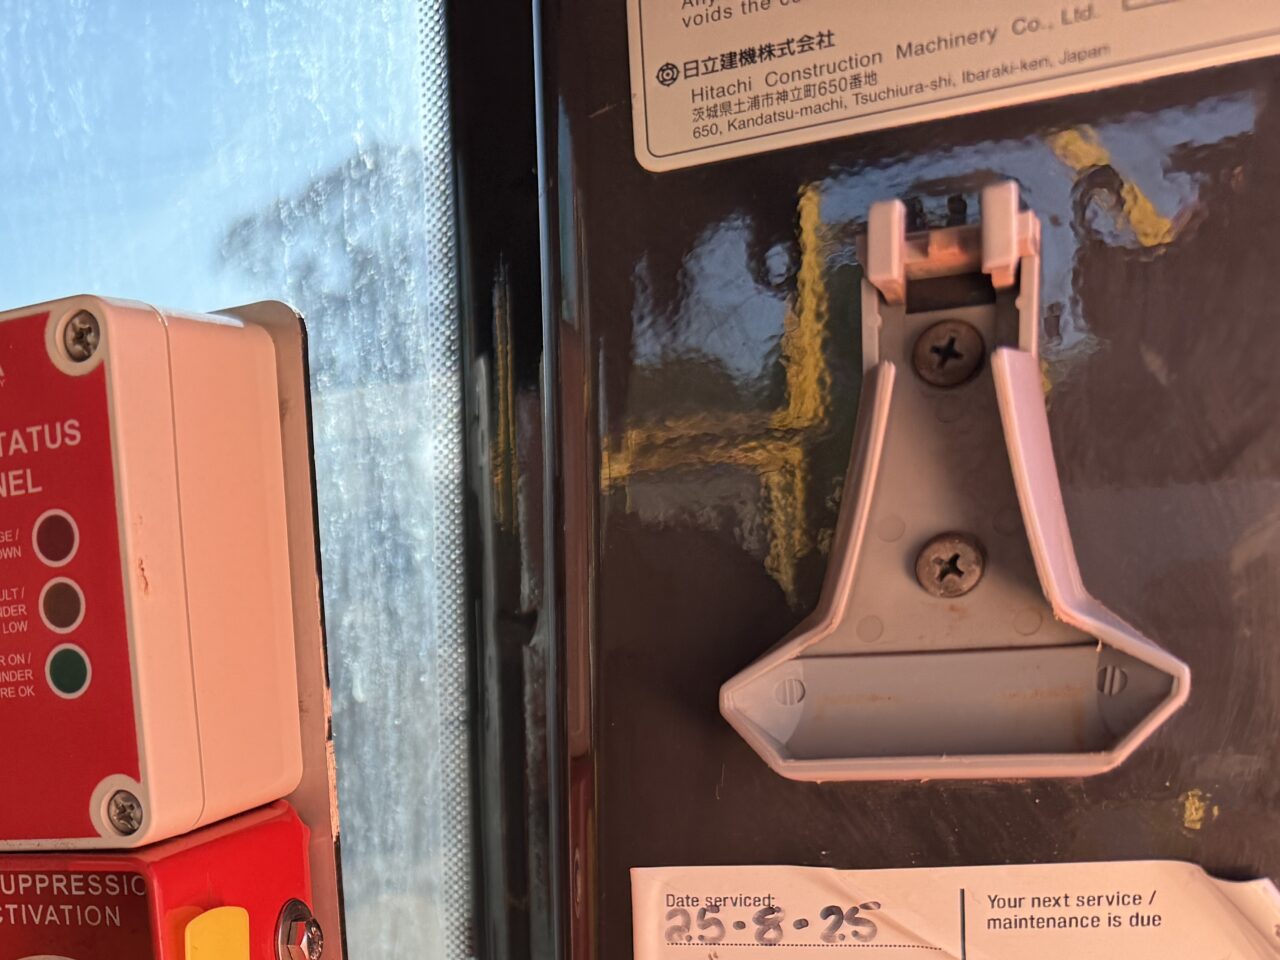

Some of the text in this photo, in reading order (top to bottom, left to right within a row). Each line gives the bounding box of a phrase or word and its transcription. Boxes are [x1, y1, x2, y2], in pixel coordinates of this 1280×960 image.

[682, 0, 771, 28] voids the
[683, 29, 836, 80] 日立建機株式会社
[691, 76, 753, 103] Hitachi
[765, 51, 883, 88] Construction
[896, 26, 998, 60] Machinery
[692, 71, 878, 123] 茨城県土浦市神立町650番地
[727, 97, 847, 132] Kandatsu-machi,
[852, 76, 956, 106] Tsuchiura-shi,
[962, 56, 1052, 84] Ibaraki-ken,
[1058, 43, 1111, 66] Japan
[2, 620, 28, 634] LOW
[8, 653, 26, 667] ON
[18, 685, 36, 698] OK
[666, 893, 775, 908] Date serviced:
[987, 889, 1157, 909] Your next service /
[987, 911, 1162, 930] maintenance is due
